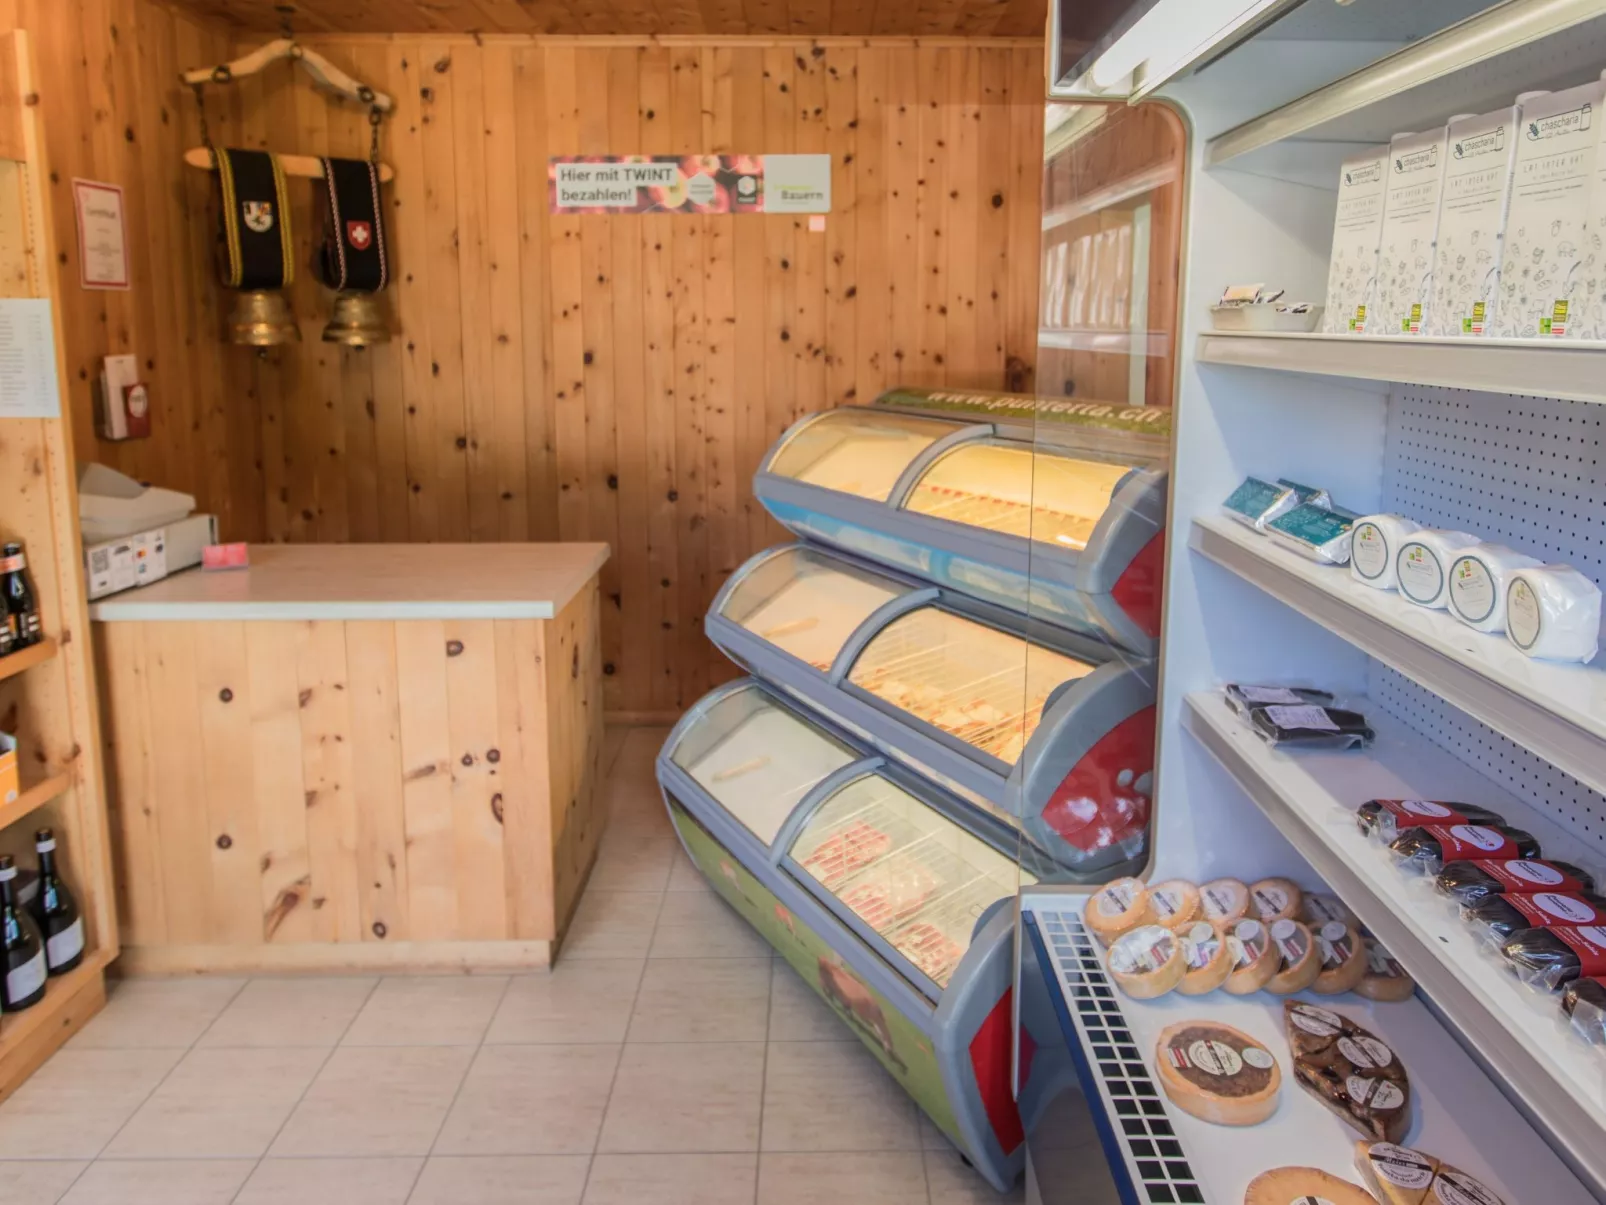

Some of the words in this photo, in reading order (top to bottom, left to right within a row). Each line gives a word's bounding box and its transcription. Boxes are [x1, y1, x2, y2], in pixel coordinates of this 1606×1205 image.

[1541, 115, 1579, 132] chascharia
[560, 168, 593, 182] Hier
[595, 168, 620, 181] mit
[623, 168, 673, 181] TWINT
[561, 187, 632, 201] bezahlen!
[781, 190, 824, 200] Bauern
